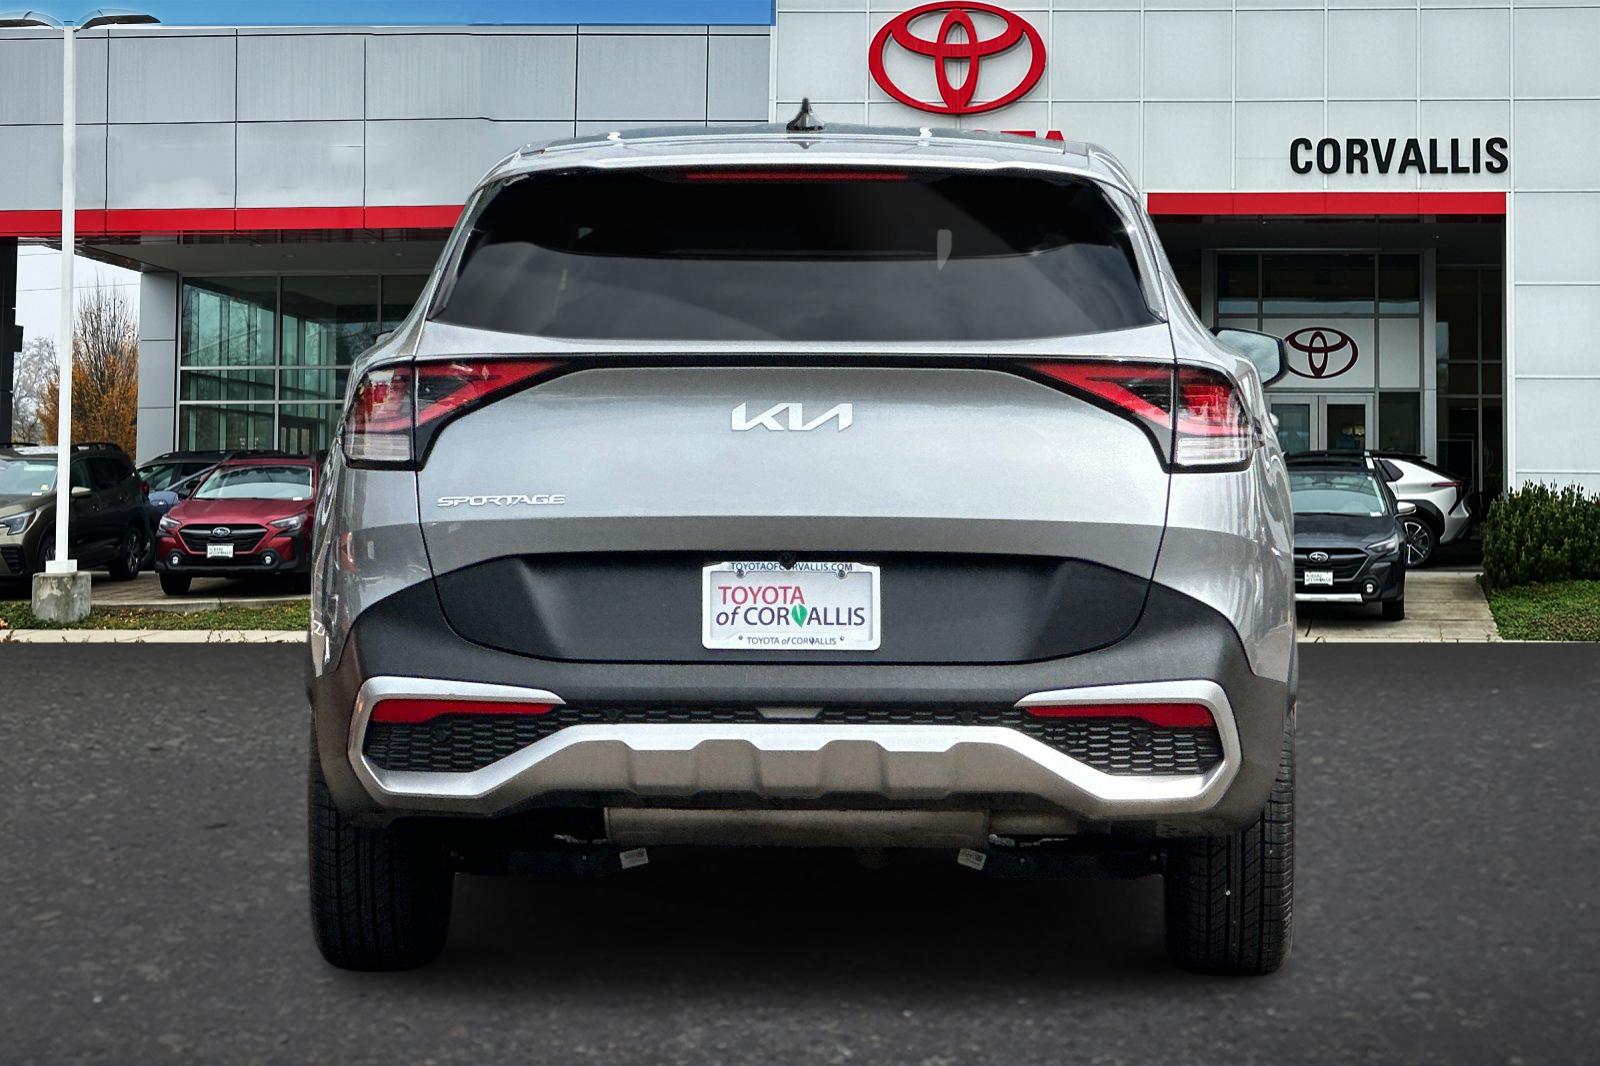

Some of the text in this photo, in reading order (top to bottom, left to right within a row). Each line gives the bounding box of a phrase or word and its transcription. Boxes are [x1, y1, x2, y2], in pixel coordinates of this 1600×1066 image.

[1290, 137, 1509, 174] CORVALLIS
[731, 402, 853, 431] KIA
[437, 494, 566, 507] SPORTAGE
[731, 562, 852, 571] TOYOTAOFCRVALLIS.COM
[718, 586, 805, 605] TOYOTA
[716, 606, 739, 626] of
[746, 637, 779, 645] TOYOTA
[781, 636, 791, 645] of
